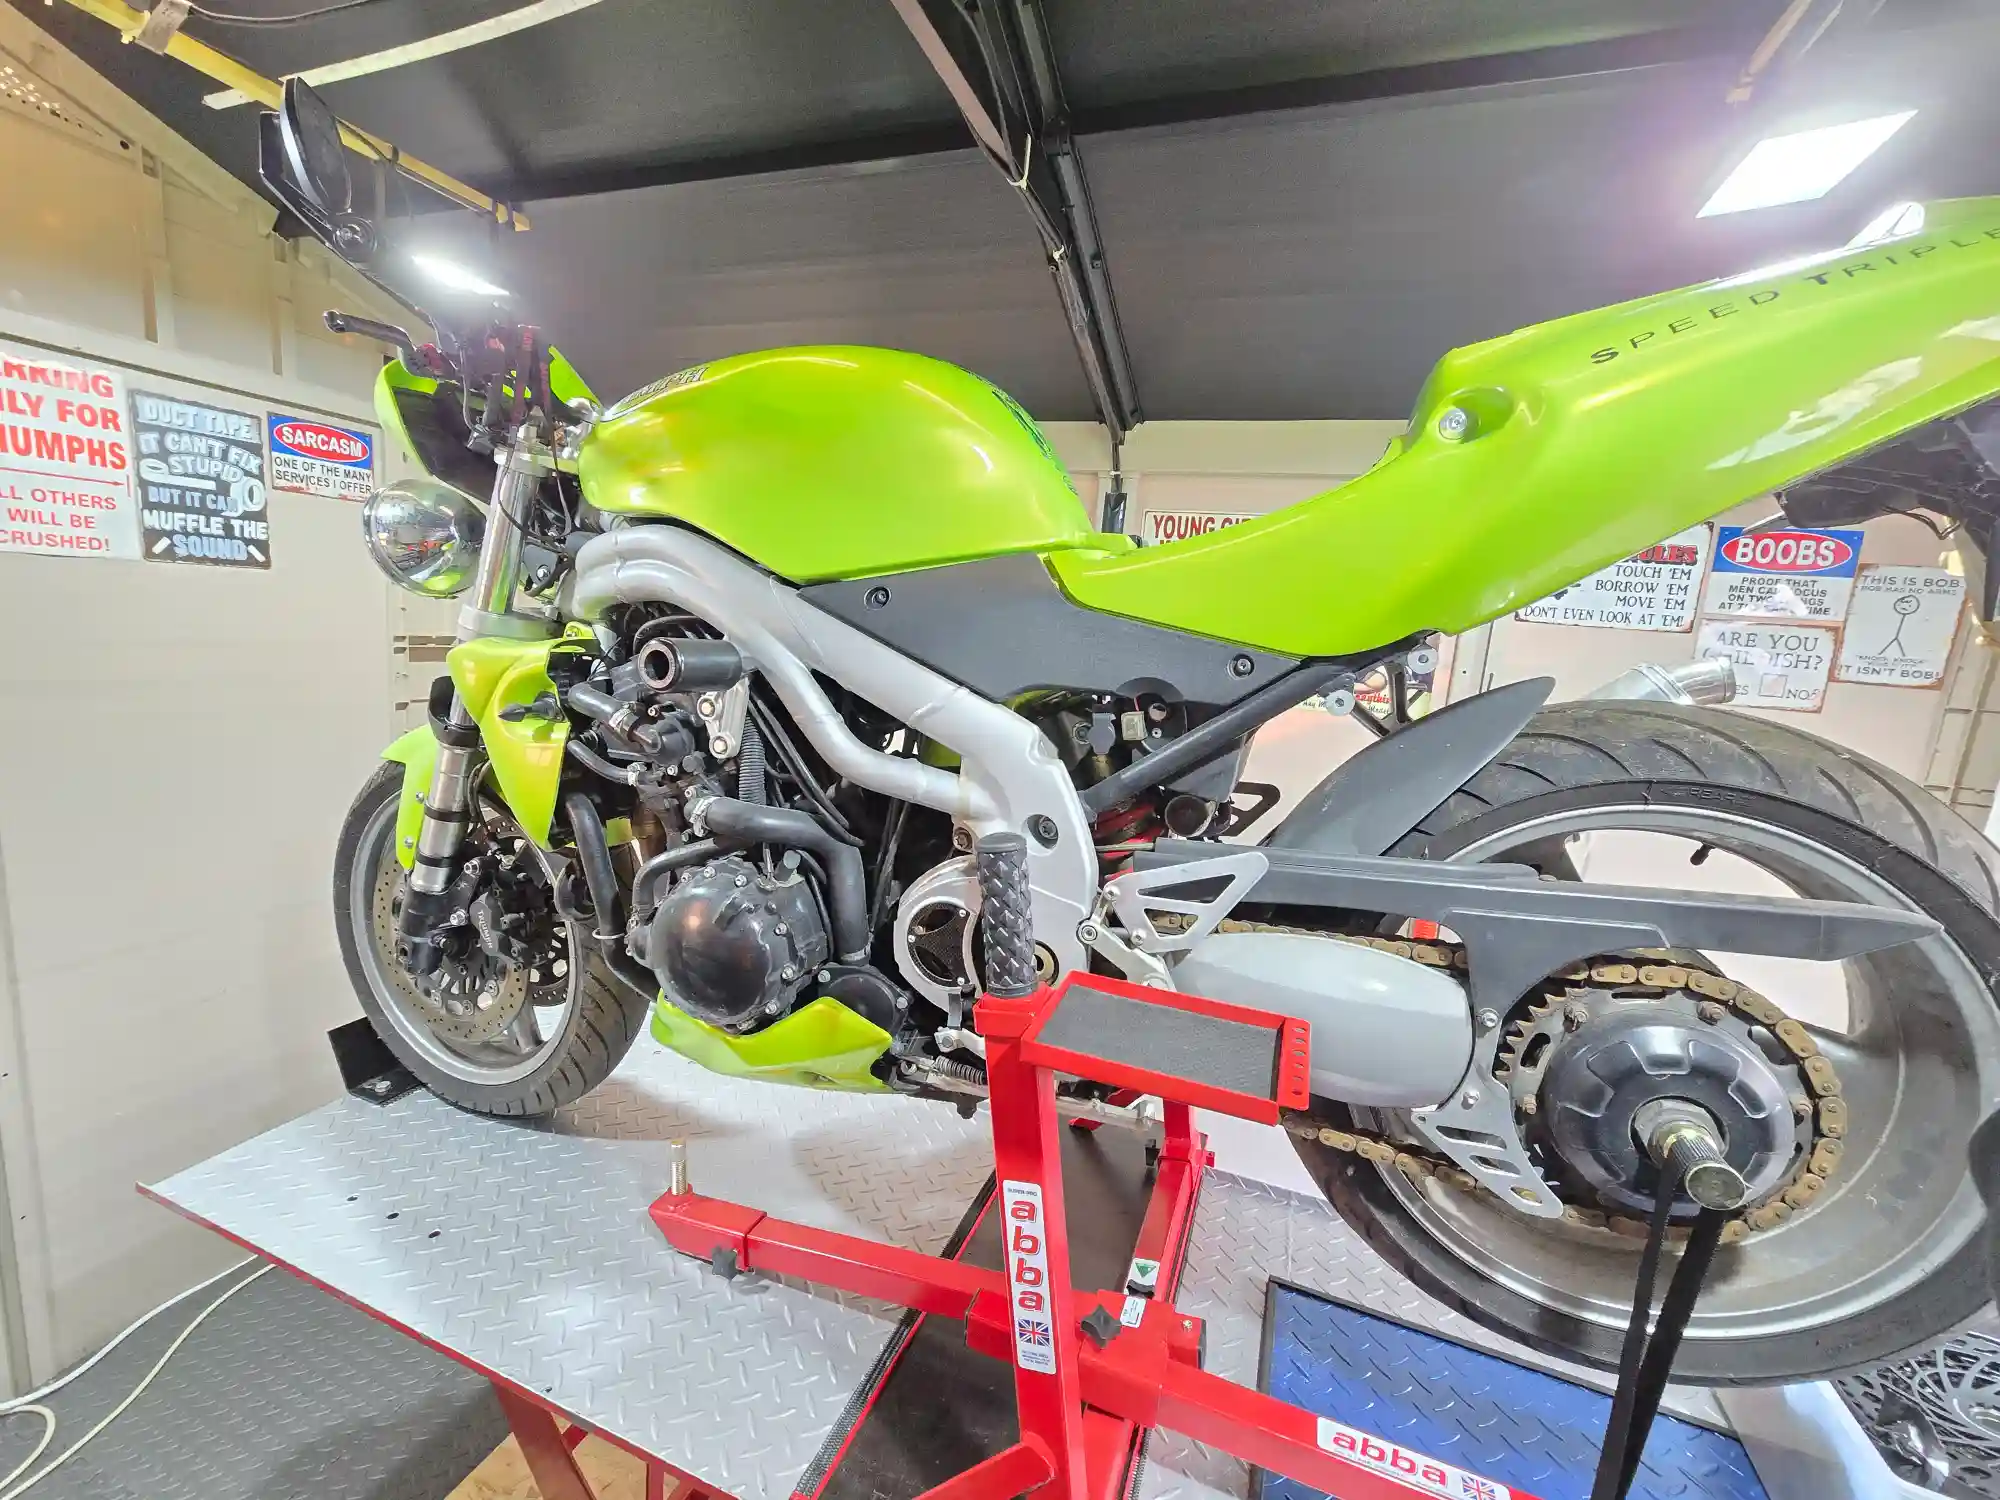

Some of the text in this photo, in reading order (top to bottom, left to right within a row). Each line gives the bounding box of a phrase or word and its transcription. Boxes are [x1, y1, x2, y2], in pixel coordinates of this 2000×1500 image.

[1590, 226, 2000, 365] SPEED TRIPLE
[0, 359, 115, 399] RKING
[56, 398, 122, 433] FOR
[144, 398, 253, 441] DUCT TAPE
[281, 426, 363, 457] SARCASM
[139, 431, 161, 456] IT
[227, 443, 263, 477] FIX
[166, 454, 244, 485] STUPID
[274, 455, 371, 484] ONE OF THE MANY
[275, 469, 331, 487] SERVICES
[339, 479, 372, 495] OFFER
[30, 488, 117, 511] OTHERS
[147, 484, 183, 507] BUT
[184, 489, 203, 509] IT
[7, 507, 97, 530] WILL BE
[141, 507, 270, 542] MUFFLE THE
[1153, 513, 1216, 540] YOUNG
[0, 529, 111, 553] CRUSHED!
[171, 532, 249, 562] SOUND
[1735, 537, 1837, 567] BOOBS
[1630, 543, 1699, 566] ULES
[1616, 564, 1663, 579] TOUCH
[1741, 576, 1819, 588] PROOF THAT
[1861, 574, 1897, 586] THIS
[1903, 576, 1917, 586] IS
[1595, 578, 1660, 594] BORROW
[1728, 585, 1754, 594] MEN
[1793, 588, 1828, 598] OCUS
[1614, 595, 1657, 609] MOVE
[1718, 601, 1735, 611] AT
[1727, 593, 1745, 603] ON
[1800, 597, 1825, 607] NGS
[1523, 604, 1558, 619] DON'T
[1563, 607, 1595, 622] EVEN
[1599, 609, 1633, 625] LOOK
[1639, 613, 1654, 627] AT
[1716, 631, 1820, 652] ARE YOU
[1702, 647, 1823, 671] CILISH?
[1856, 665, 1896, 677] ISN'T
[1688, 786, 1737, 804] REAR
[1010, 1199, 1045, 1313] abba
[1332, 1431, 1448, 1488] abba
